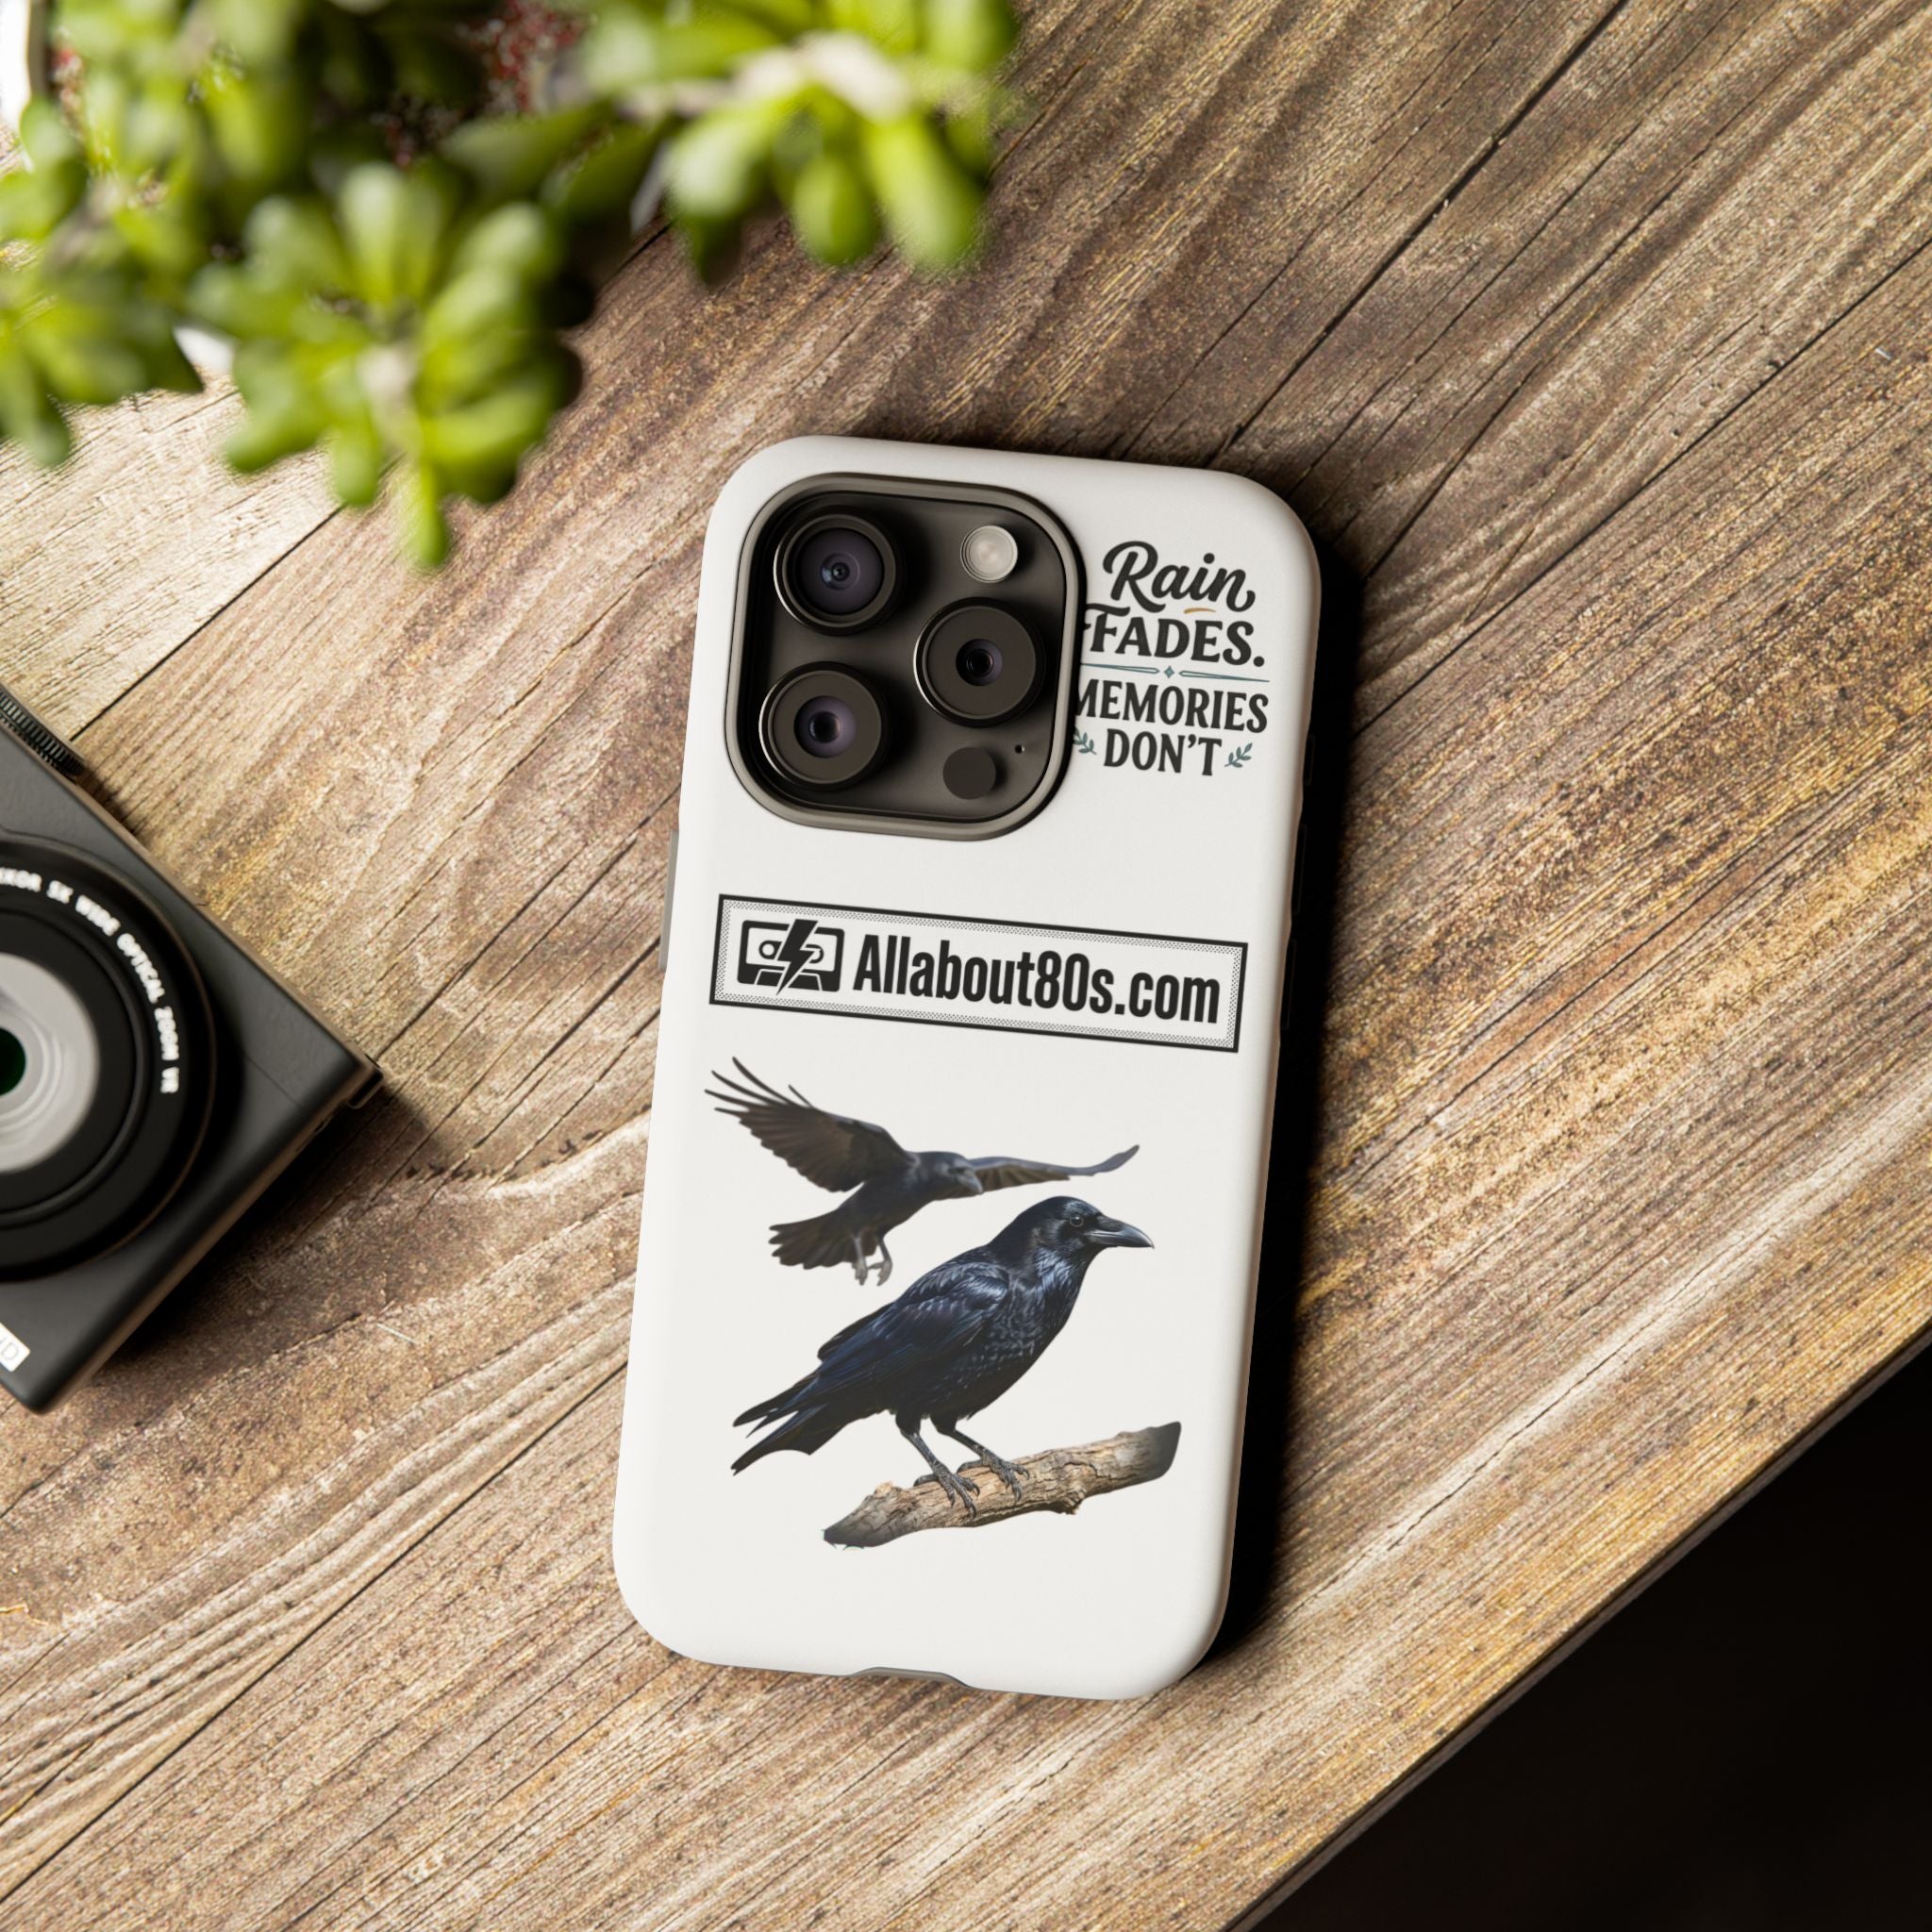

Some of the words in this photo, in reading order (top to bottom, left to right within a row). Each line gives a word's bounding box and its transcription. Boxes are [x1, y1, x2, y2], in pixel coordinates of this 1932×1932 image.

[1103, 541, 1256, 613] Rain
[1084, 603, 1265, 667] FADES.
[1076, 678, 1269, 733] MEMORIES
[1104, 728, 1223, 776] DON’T
[75, 895, 121, 936] WIDE
[117, 933, 165, 1004] OPTICAL
[154, 1007, 179, 1060] ZOOM
[853, 934, 1221, 1024] Allabout80s.com
